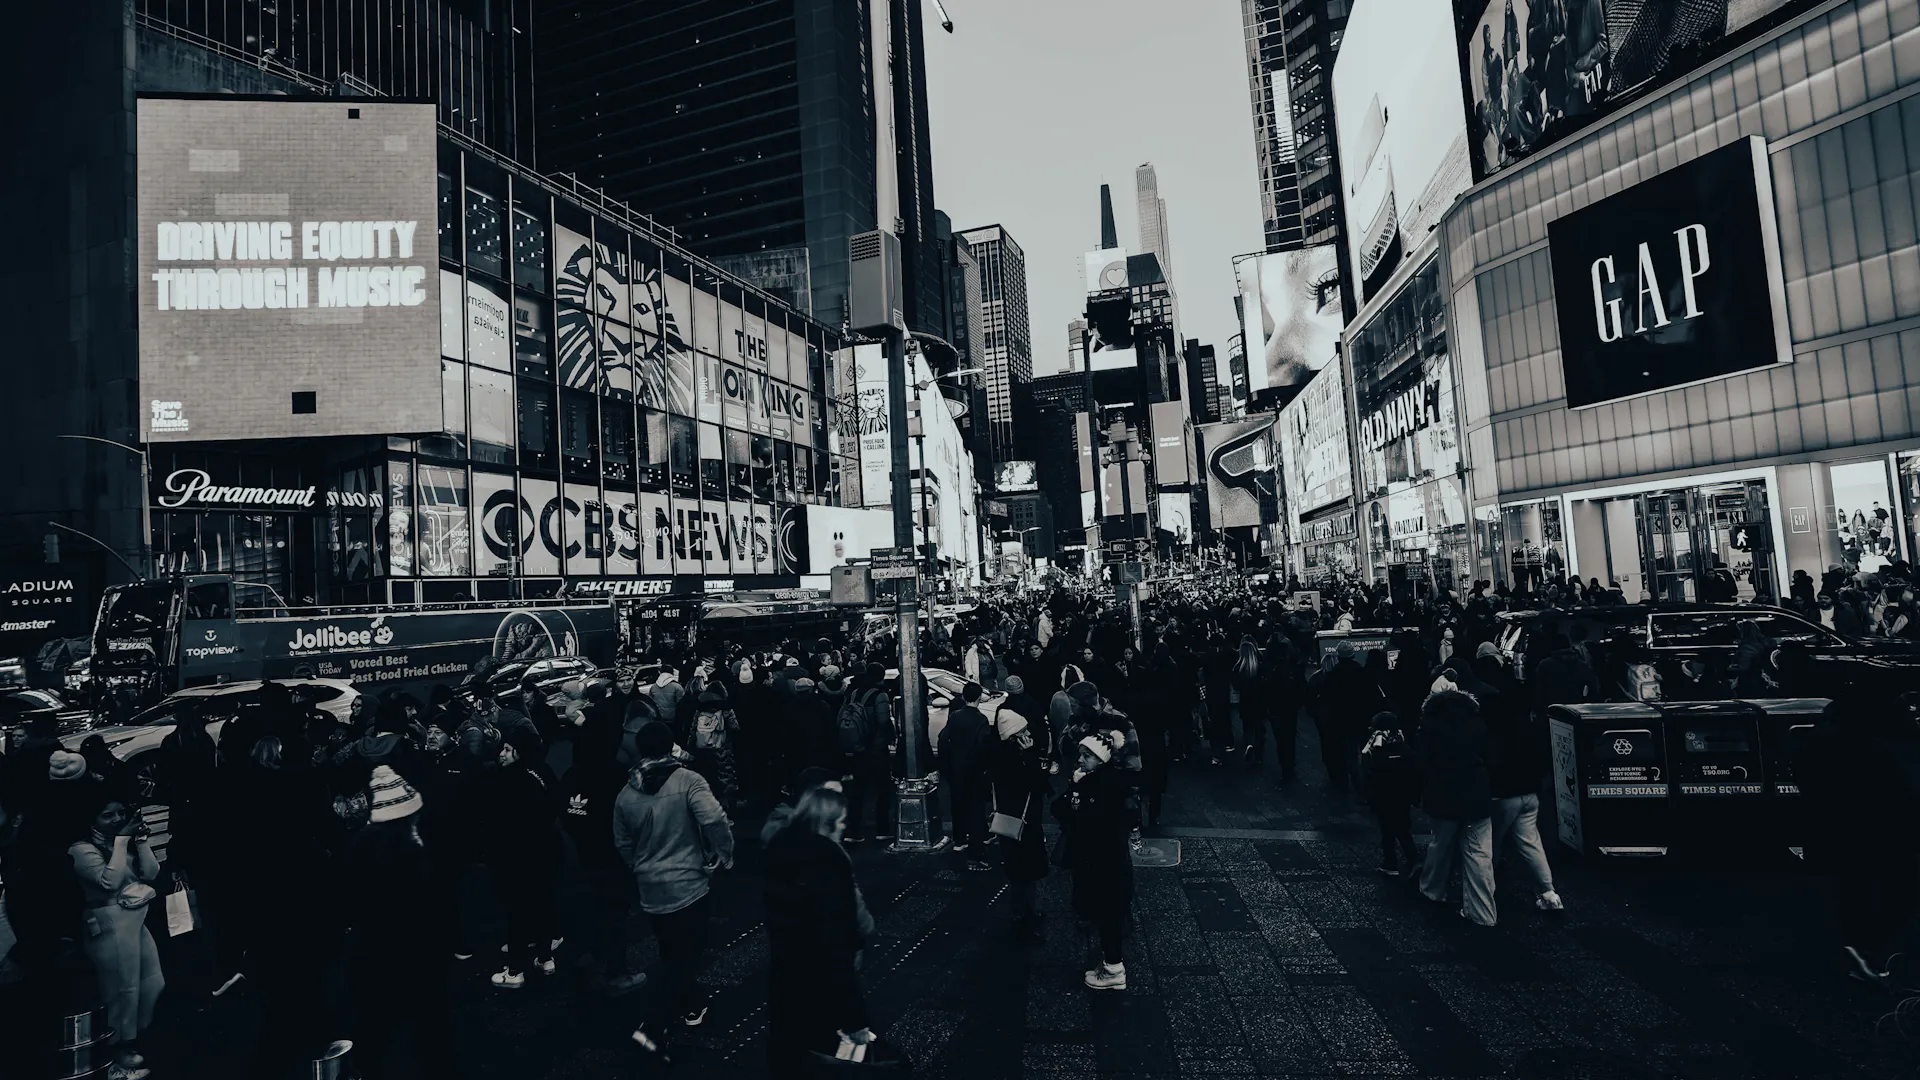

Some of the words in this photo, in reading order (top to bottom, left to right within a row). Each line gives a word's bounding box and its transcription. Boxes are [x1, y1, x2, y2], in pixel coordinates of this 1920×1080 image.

[1583, 62, 1603, 104] GAP
[157, 222, 292, 260] DRIVING
[302, 220, 418, 261] EQUITY
[152, 268, 308, 311] THROUGH
[318, 266, 426, 308] MUSIC
[1590, 223, 1711, 343] GAP
[952, 276, 965, 340] TIMES
[734, 329, 766, 362] THE
[757, 368, 804, 419] KING
[1361, 410, 1386, 454] OLD
[1386, 381, 1426, 441] NAVY
[158, 468, 316, 508] Paramount
[540, 496, 640, 562] CBS
[656, 506, 769, 563] NEWS
[1794, 514, 1806, 526] GAP
[1, 579, 74, 594] ADIUM
[12, 596, 73, 606] SQUARE
[575, 580, 673, 596] SKECHERS
[288, 624, 372, 650] Jollibee
[350, 656, 383, 669] Voted
[385, 655, 408, 666] Best
[375, 669, 401, 680] Food
[404, 665, 428, 678] Fried
[430, 662, 468, 675] Chicken
[1590, 787, 1622, 795] TIMES
[1625, 787, 1666, 796] SQUARE
[1682, 786, 1716, 794] TIMES
[1719, 785, 1762, 794] SQUARE
